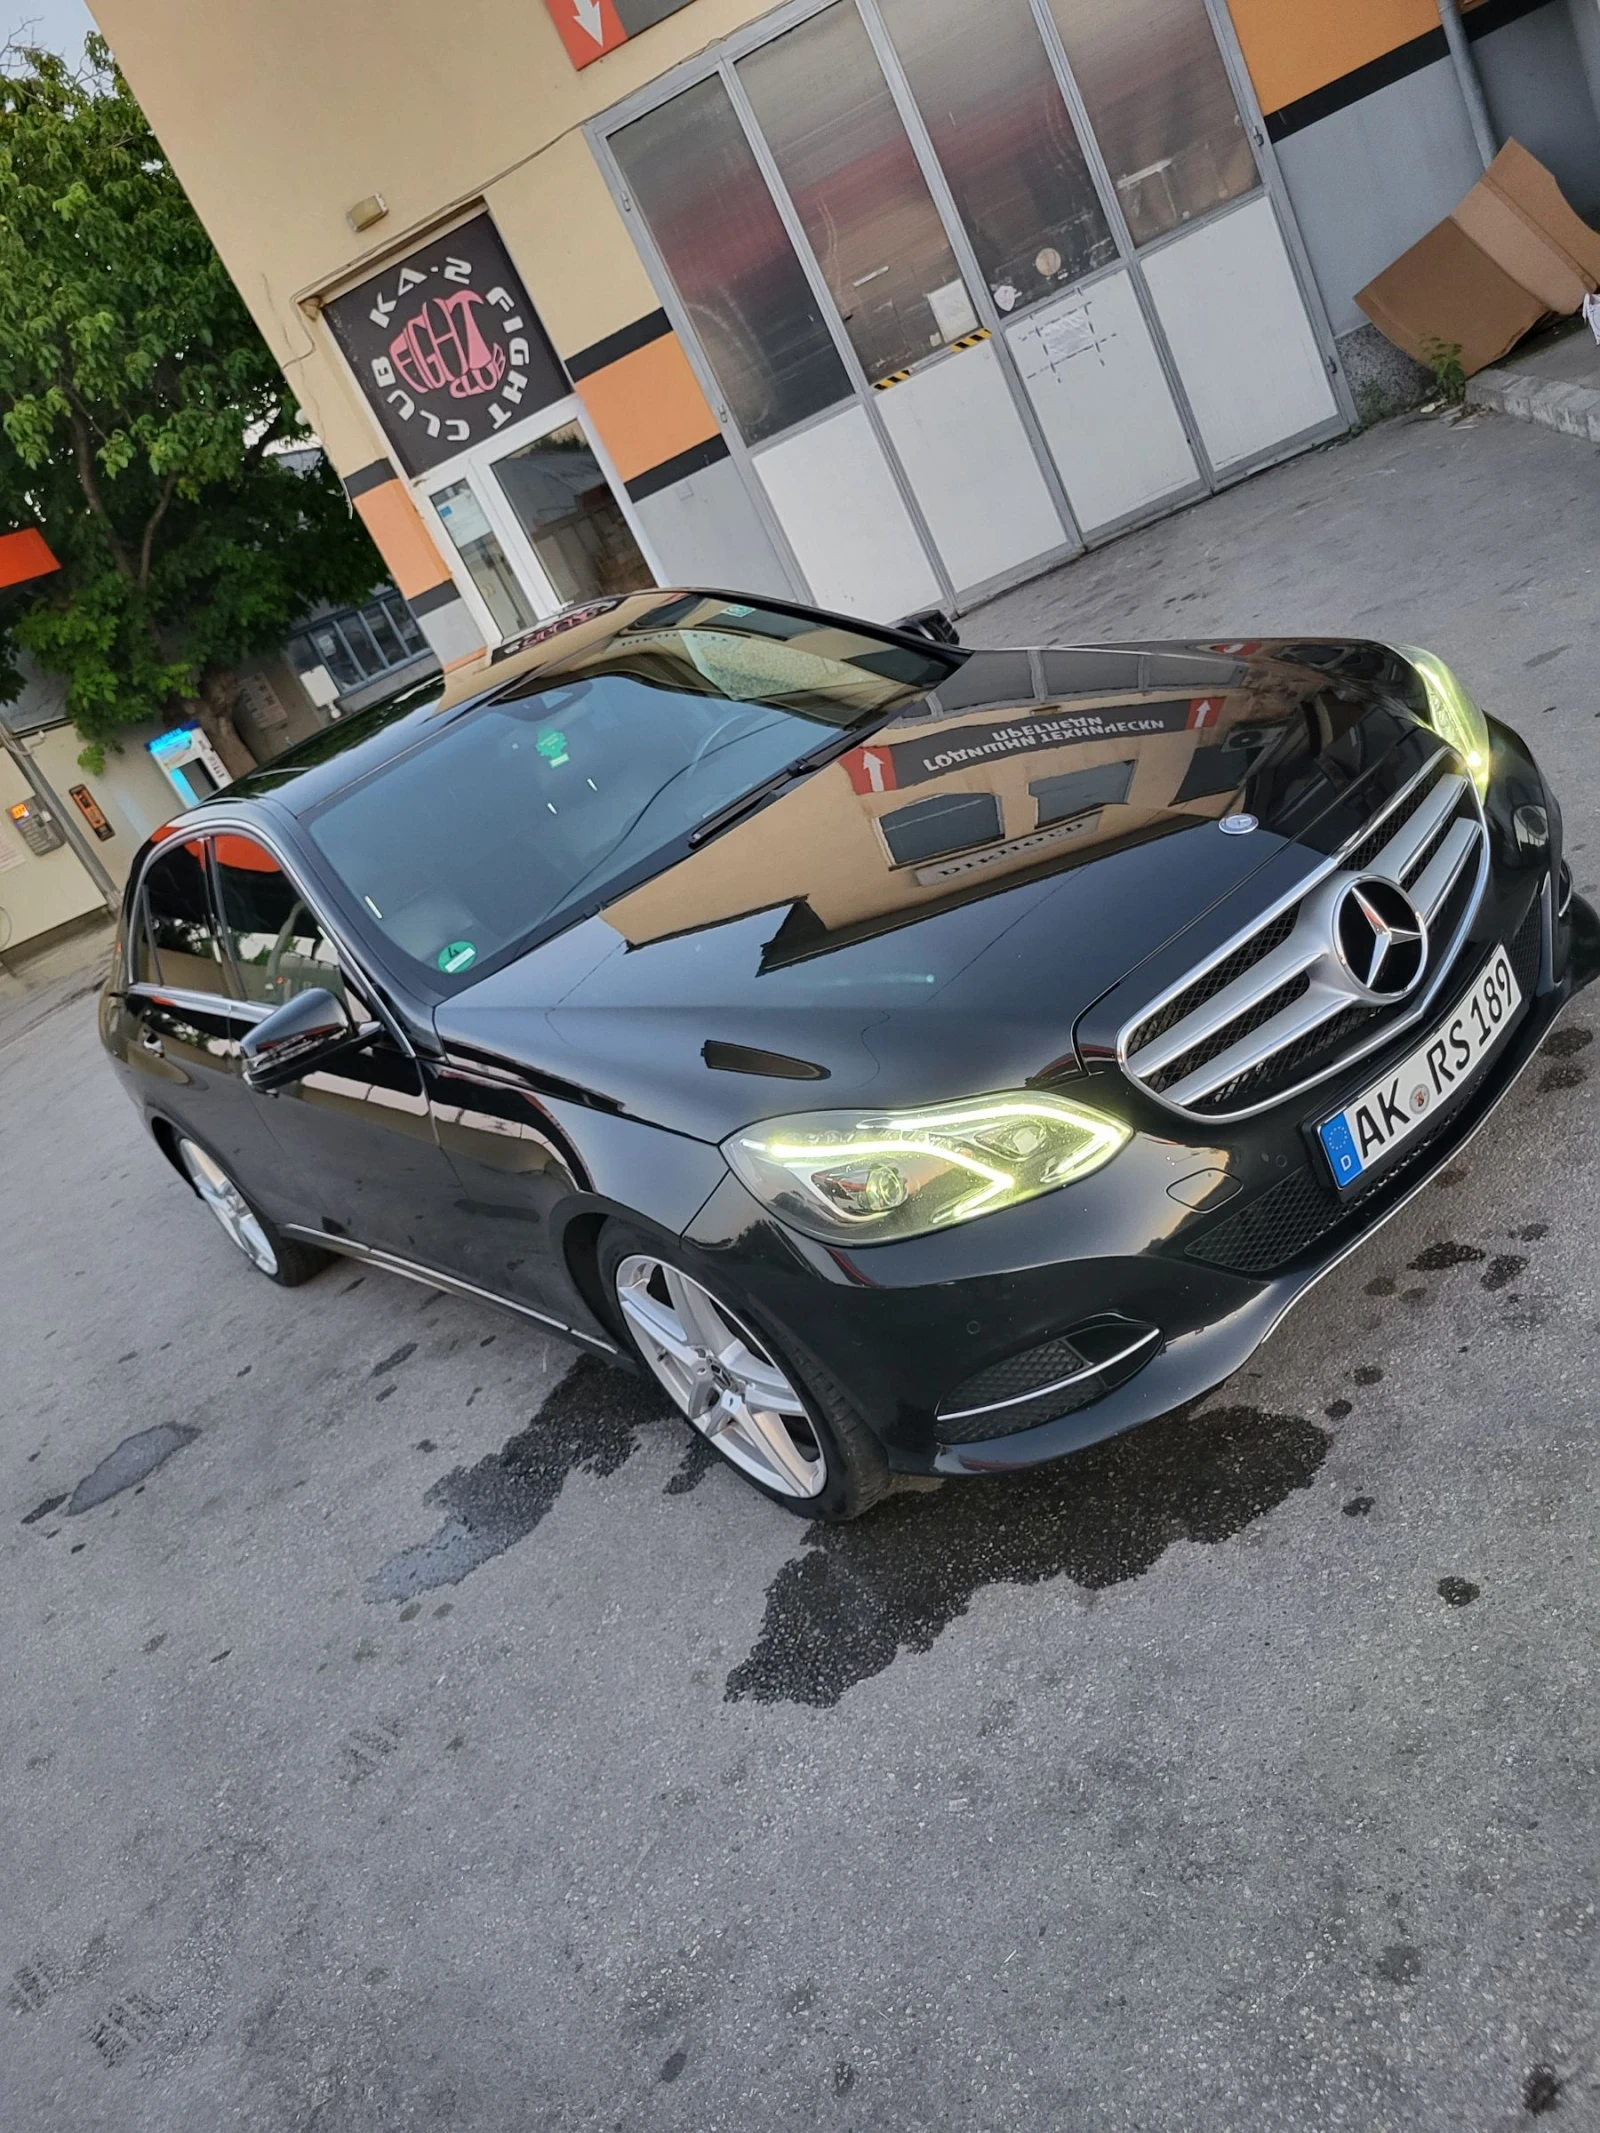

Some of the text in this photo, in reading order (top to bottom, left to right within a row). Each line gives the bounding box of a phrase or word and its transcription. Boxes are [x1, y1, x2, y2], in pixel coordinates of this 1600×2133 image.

[370, 353, 471, 442] CLUB
[449, 343, 506, 399] CLUB
[485, 286, 530, 429] FIGHT
[1354, 958, 1513, 1160] AK RS 189
[1340, 1154, 1351, 1172] D
